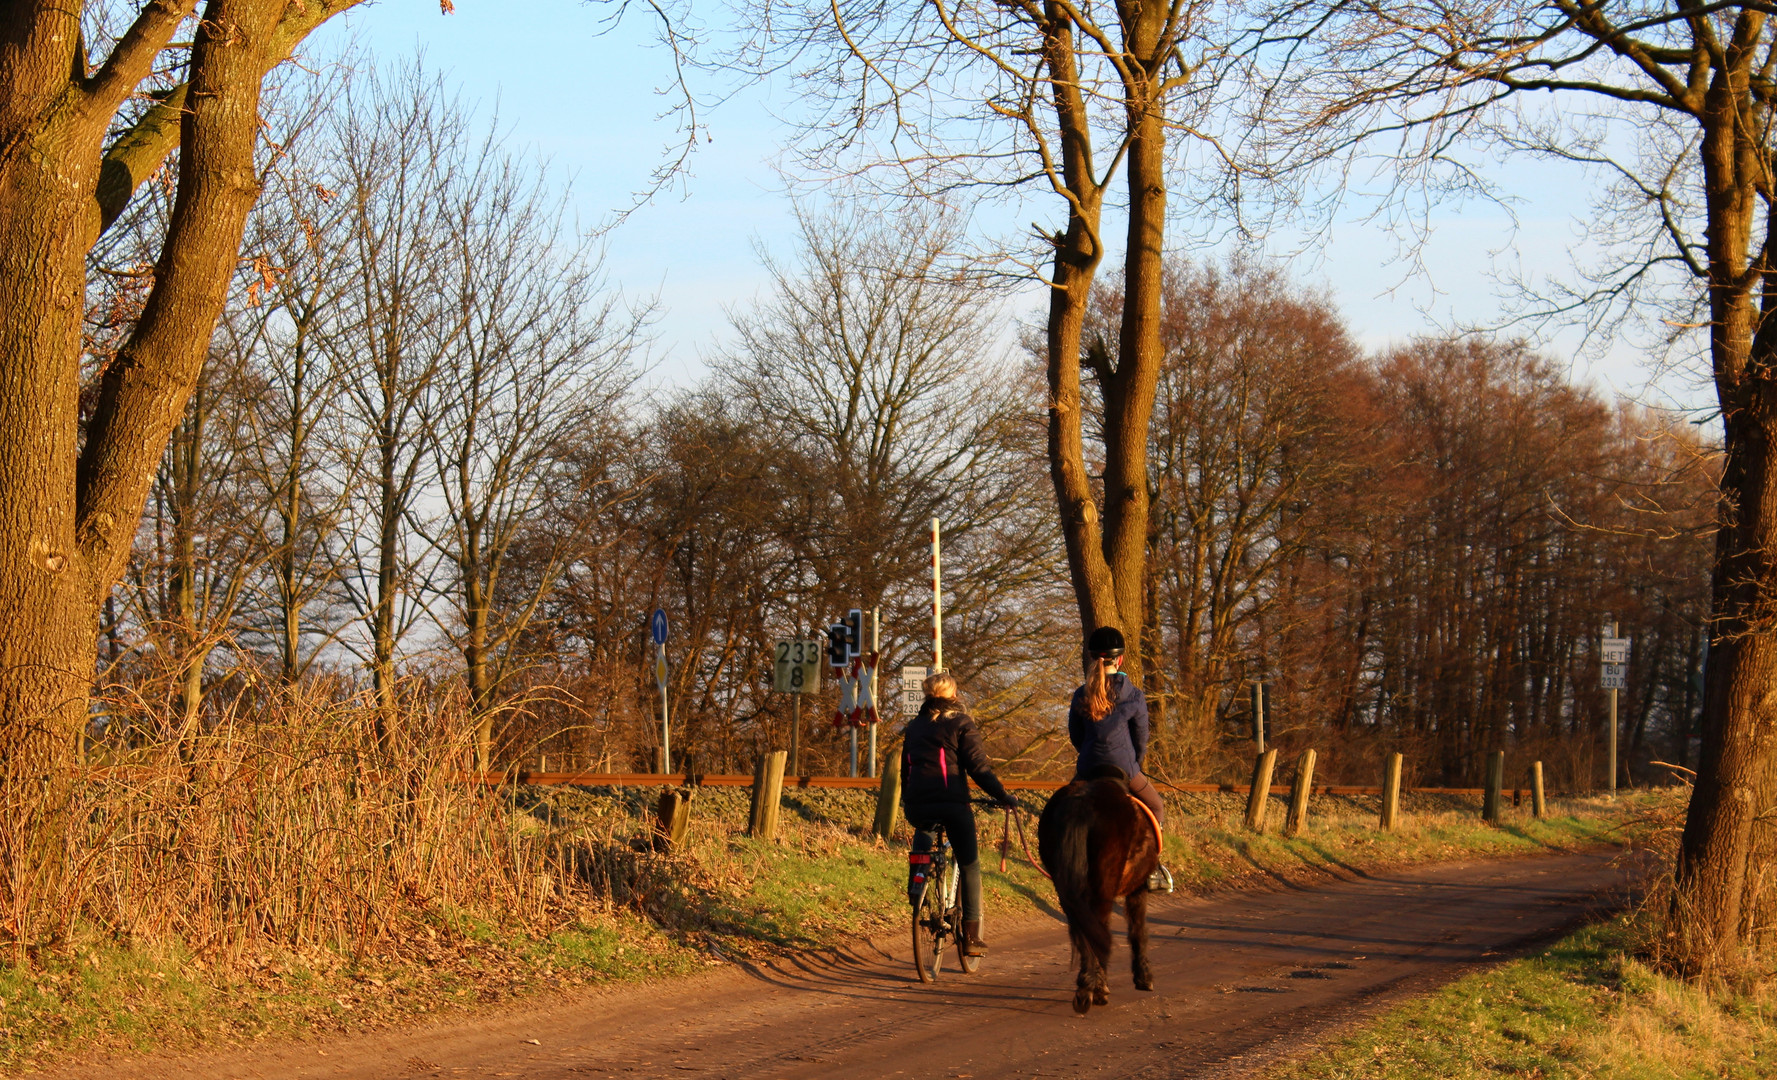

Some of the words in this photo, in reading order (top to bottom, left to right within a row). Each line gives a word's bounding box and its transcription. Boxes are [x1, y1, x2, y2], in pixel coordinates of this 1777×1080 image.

[778, 642, 819, 664] 233
[1602, 651, 1624, 660] HET
[1606, 665, 1620, 675] Bü
[790, 666, 804, 688] 8
[1602, 677, 1624, 687] 233.7
[908, 692, 922, 702] Bü
[904, 704, 919, 714] 233
